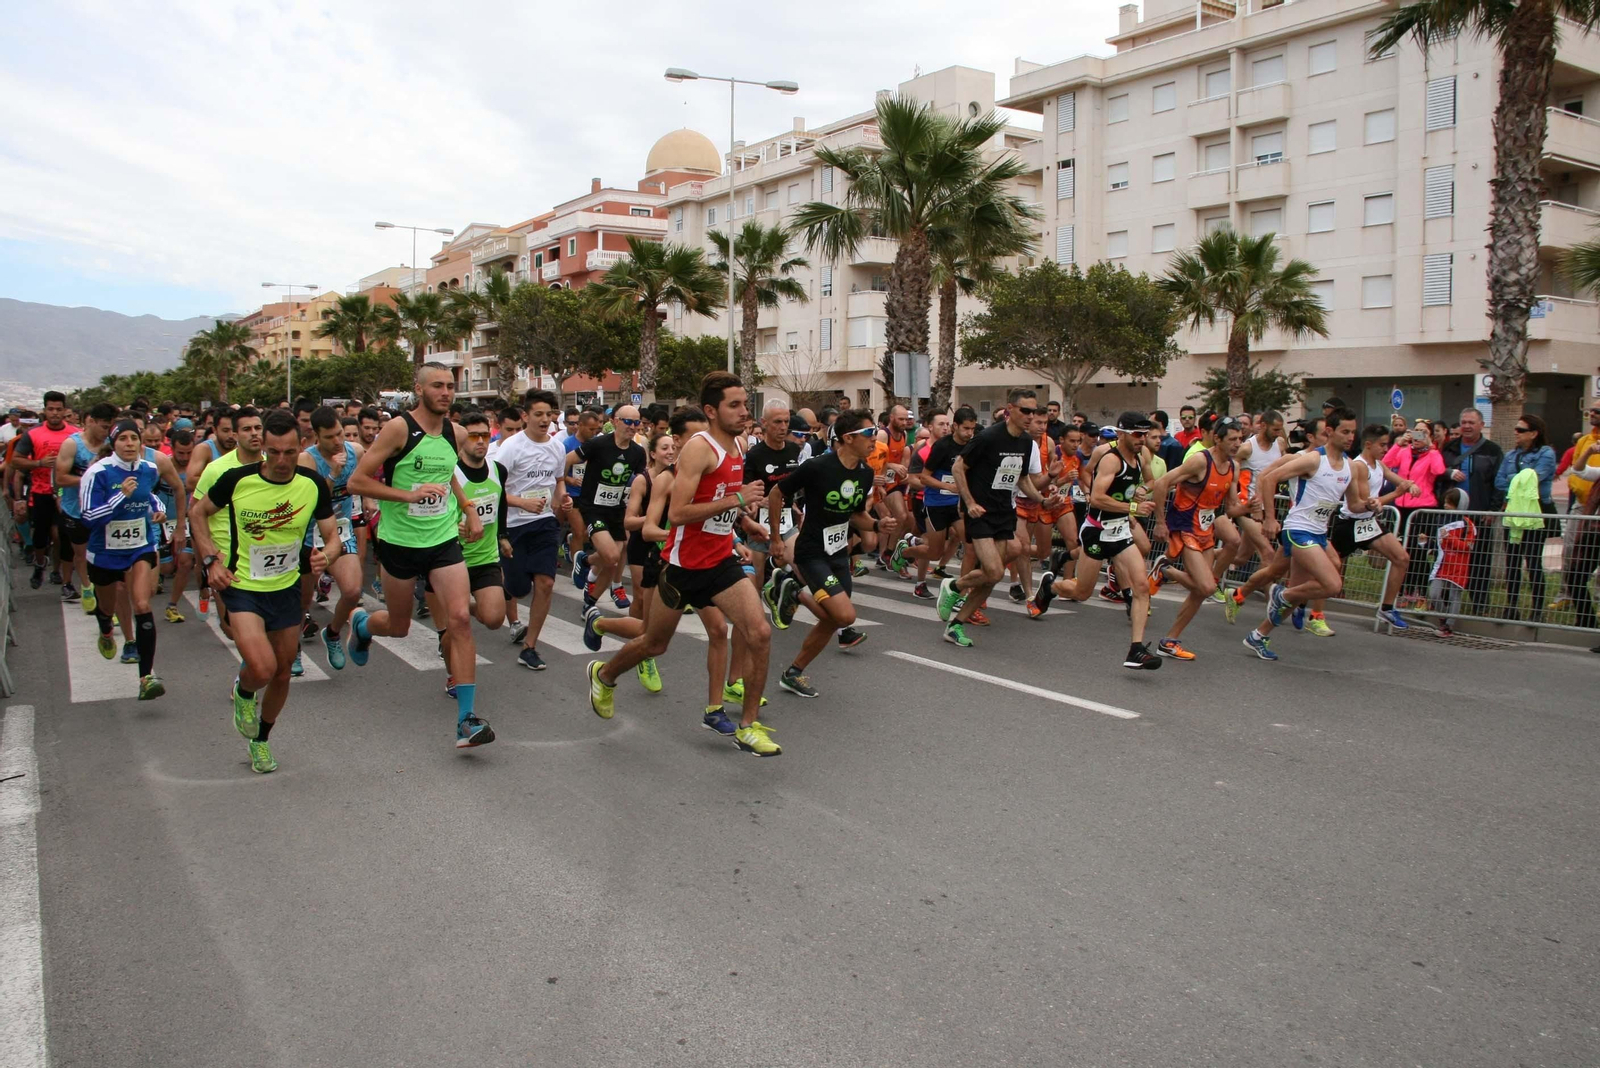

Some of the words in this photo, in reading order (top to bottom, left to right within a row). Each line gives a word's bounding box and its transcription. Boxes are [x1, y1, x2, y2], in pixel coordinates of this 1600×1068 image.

[1001, 474, 1015, 483] 68
[600, 492, 619, 500] 464
[477, 504, 493, 516] 05
[241, 511, 287, 520] BOMBER
[764, 515, 786, 524] 44
[1201, 514, 1213, 524] 24
[112, 528, 140, 540] 445
[1112, 526, 1123, 534] 16
[1356, 524, 1373, 534] 216
[828, 530, 846, 546] 568
[264, 554, 288, 568] 27
